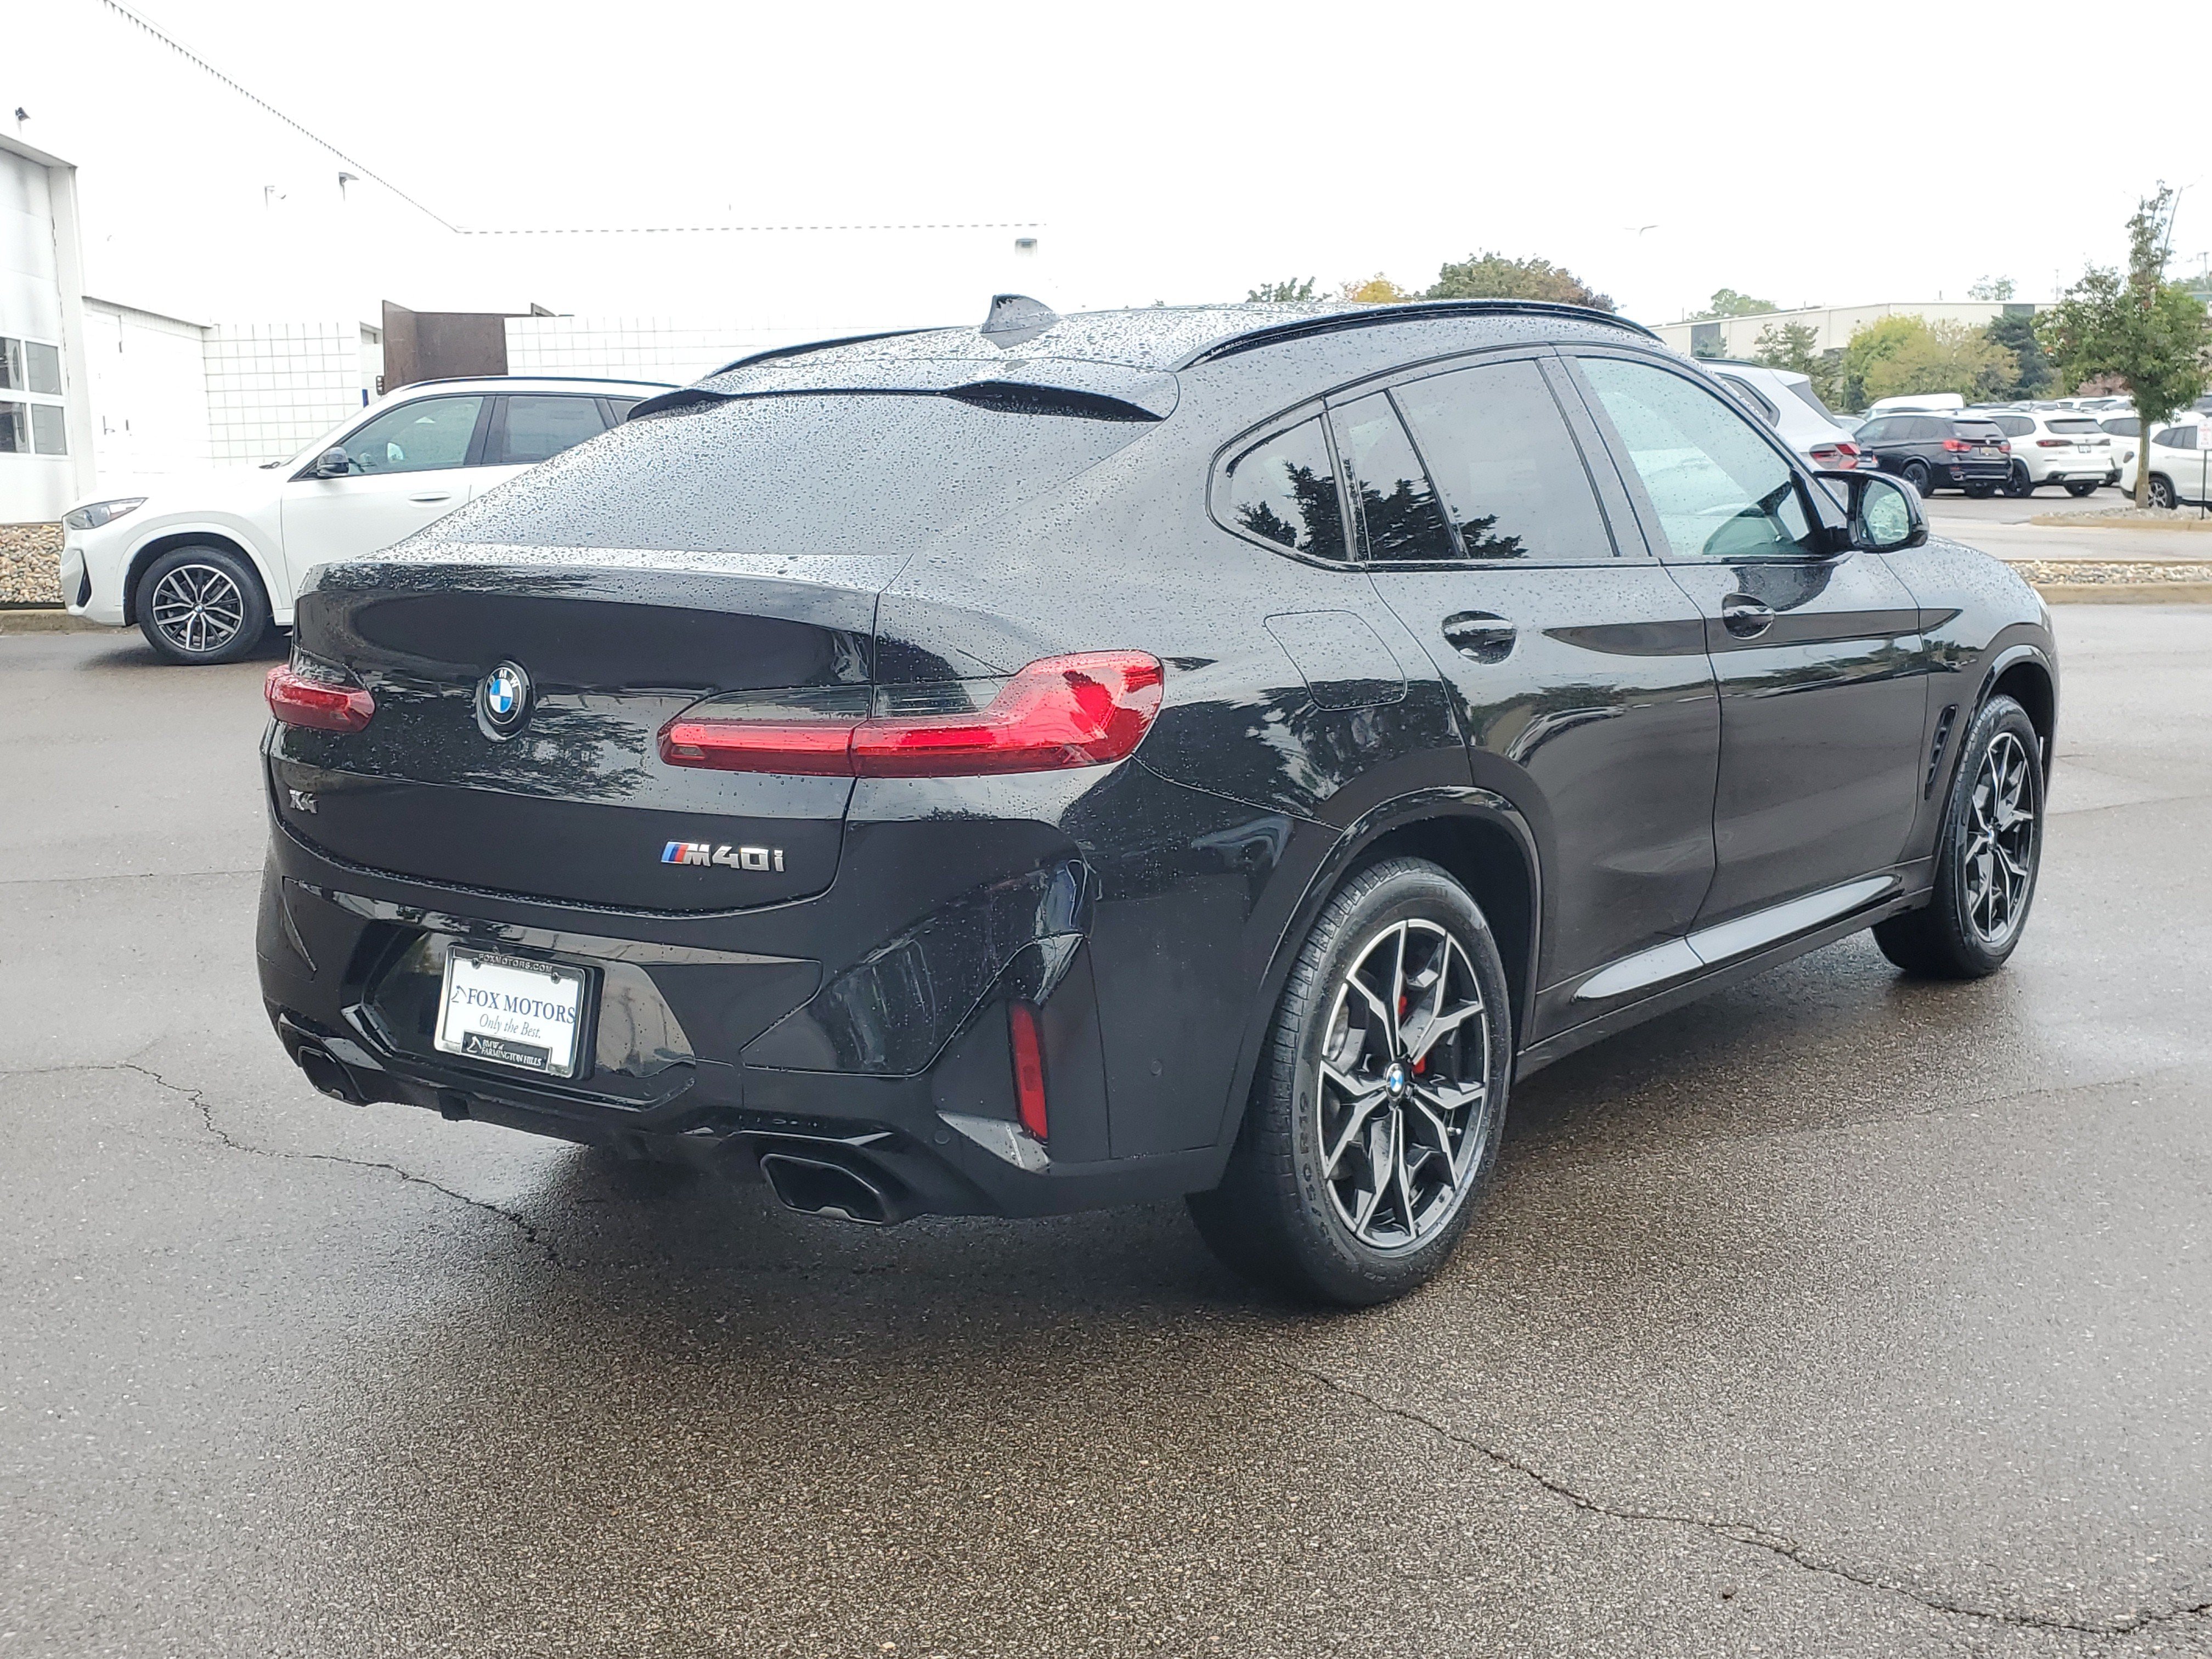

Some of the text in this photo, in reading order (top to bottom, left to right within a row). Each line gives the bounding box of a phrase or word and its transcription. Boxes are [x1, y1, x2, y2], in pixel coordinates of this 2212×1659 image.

[488, 669, 519, 688] BMW
[289, 789, 318, 814] X4
[677, 843, 785, 872] M40i
[478, 953, 552, 973] FOXMOTORS.COM
[467, 988, 575, 1024] FOX MOTORS
[480, 1014, 541, 1039] Only the Best.
[481, 1047, 543, 1066] FARMINGTON HILLS
